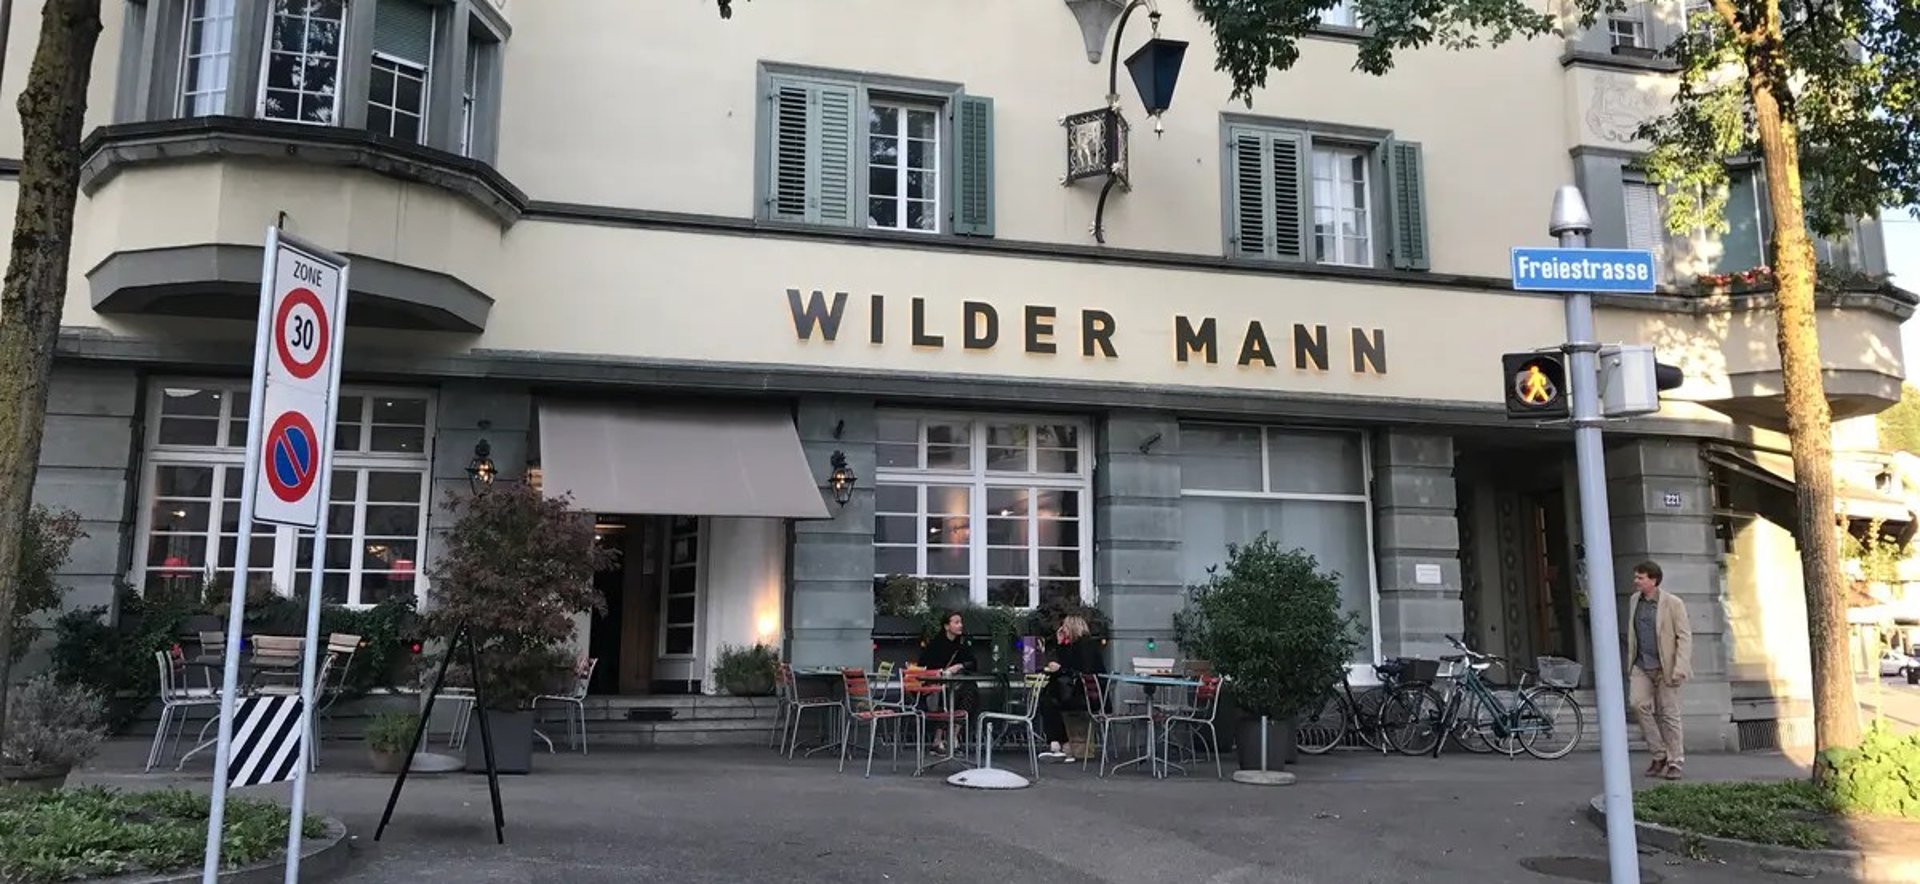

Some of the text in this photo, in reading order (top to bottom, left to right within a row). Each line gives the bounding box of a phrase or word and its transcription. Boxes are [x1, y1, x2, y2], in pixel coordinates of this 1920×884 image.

[293, 261, 322, 287] ZONE
[1518, 256, 1649, 281] Freiestrasse
[291, 315, 313, 350] 30
[786, 288, 1387, 374] WILDER MANN
[1665, 494, 1680, 505] 221
